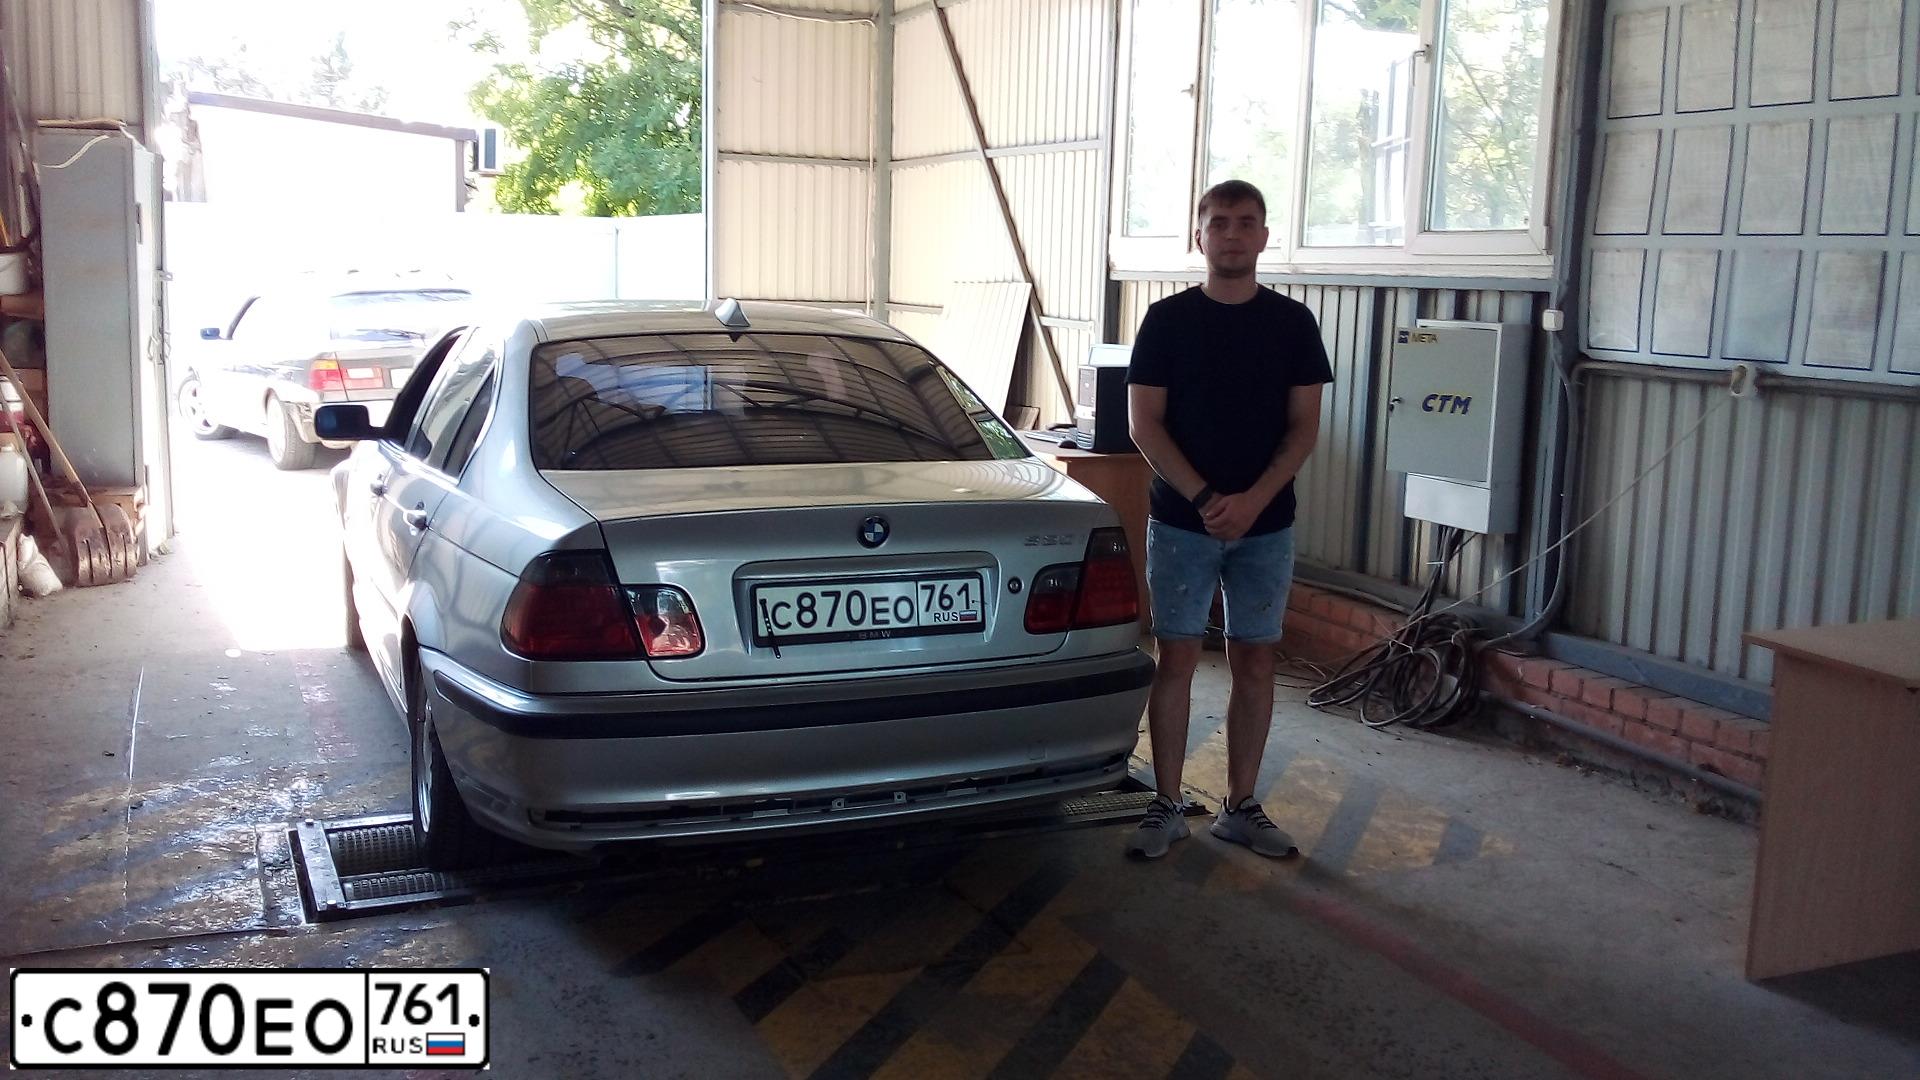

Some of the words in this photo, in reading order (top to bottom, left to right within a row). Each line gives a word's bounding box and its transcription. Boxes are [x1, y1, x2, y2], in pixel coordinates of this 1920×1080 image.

[1421, 393, 1473, 415] CTM
[771, 589, 915, 630] C870EO
[920, 581, 972, 613] 761
[933, 611, 959, 622] RUS
